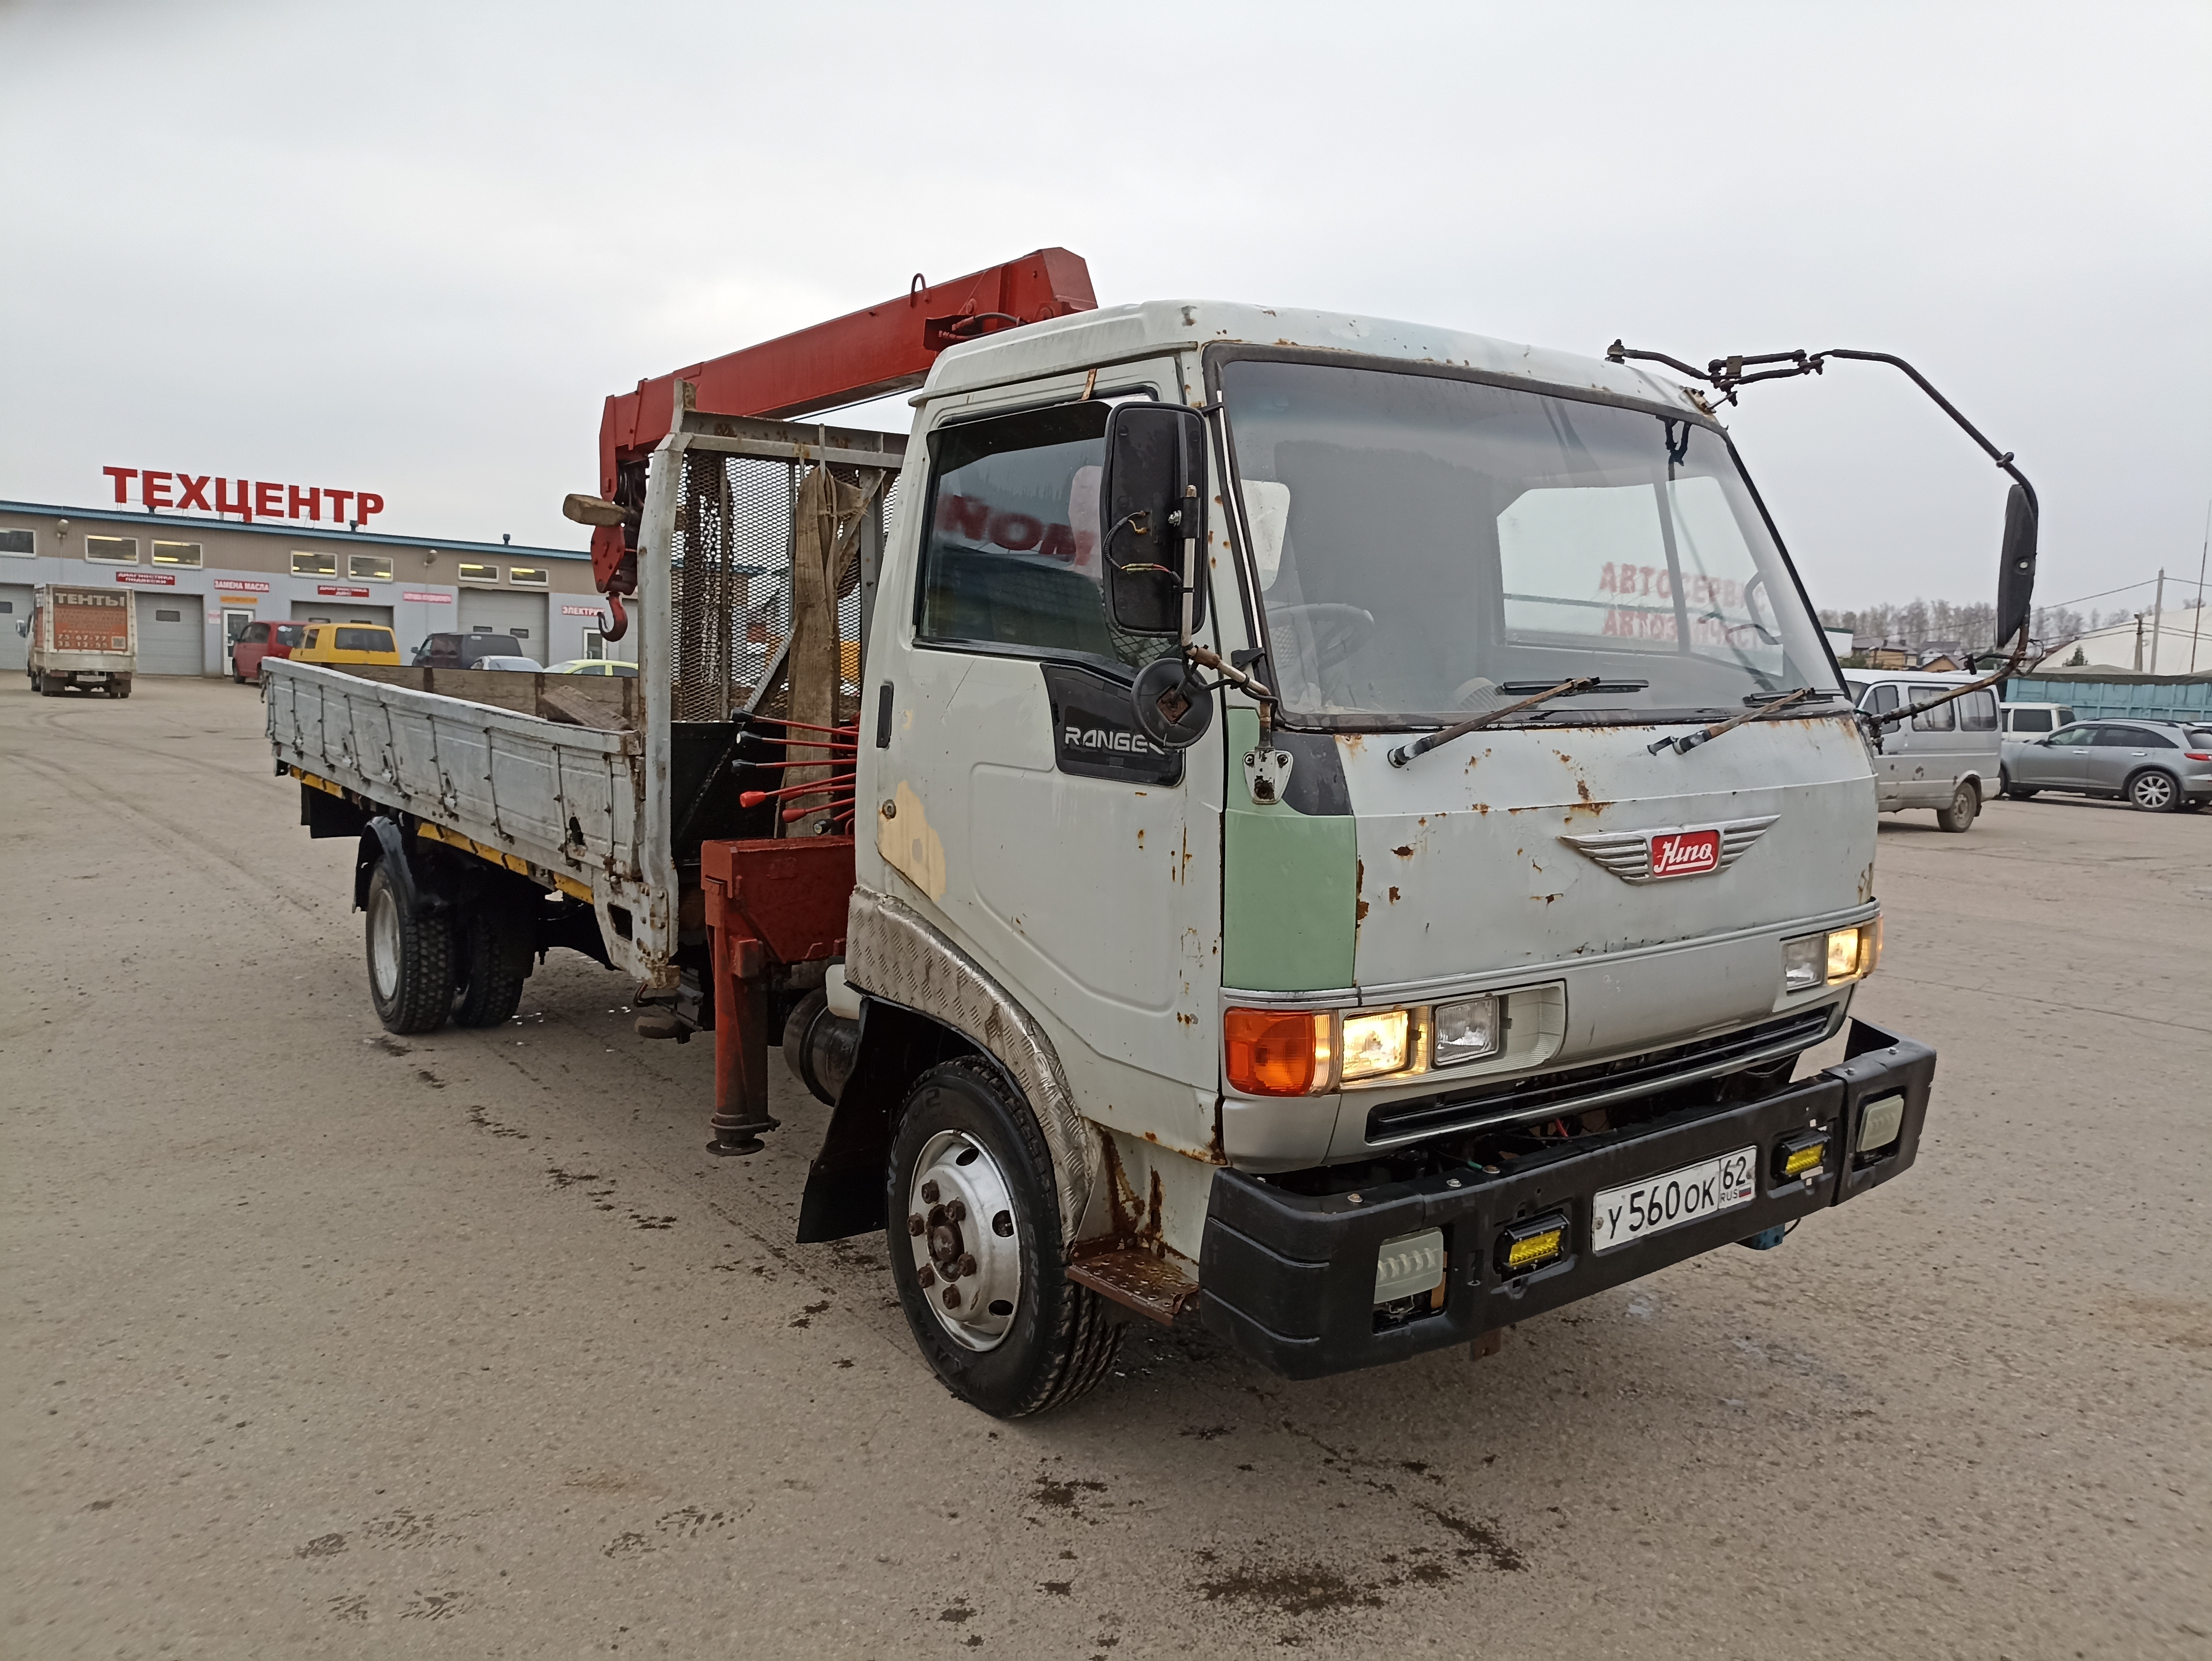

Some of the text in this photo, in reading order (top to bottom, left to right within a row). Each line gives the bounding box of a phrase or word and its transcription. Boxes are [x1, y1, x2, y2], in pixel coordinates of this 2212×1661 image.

[103, 465, 384, 525] ТЕХЦЕНТР
[215, 581, 243, 589] ЗАМЕНА
[55, 593, 124, 607] ТЕНТЫ
[1654, 836, 1714, 873] Hino
[1723, 1156, 1746, 1189] 62
[1721, 1191, 1738, 1203] RUS
